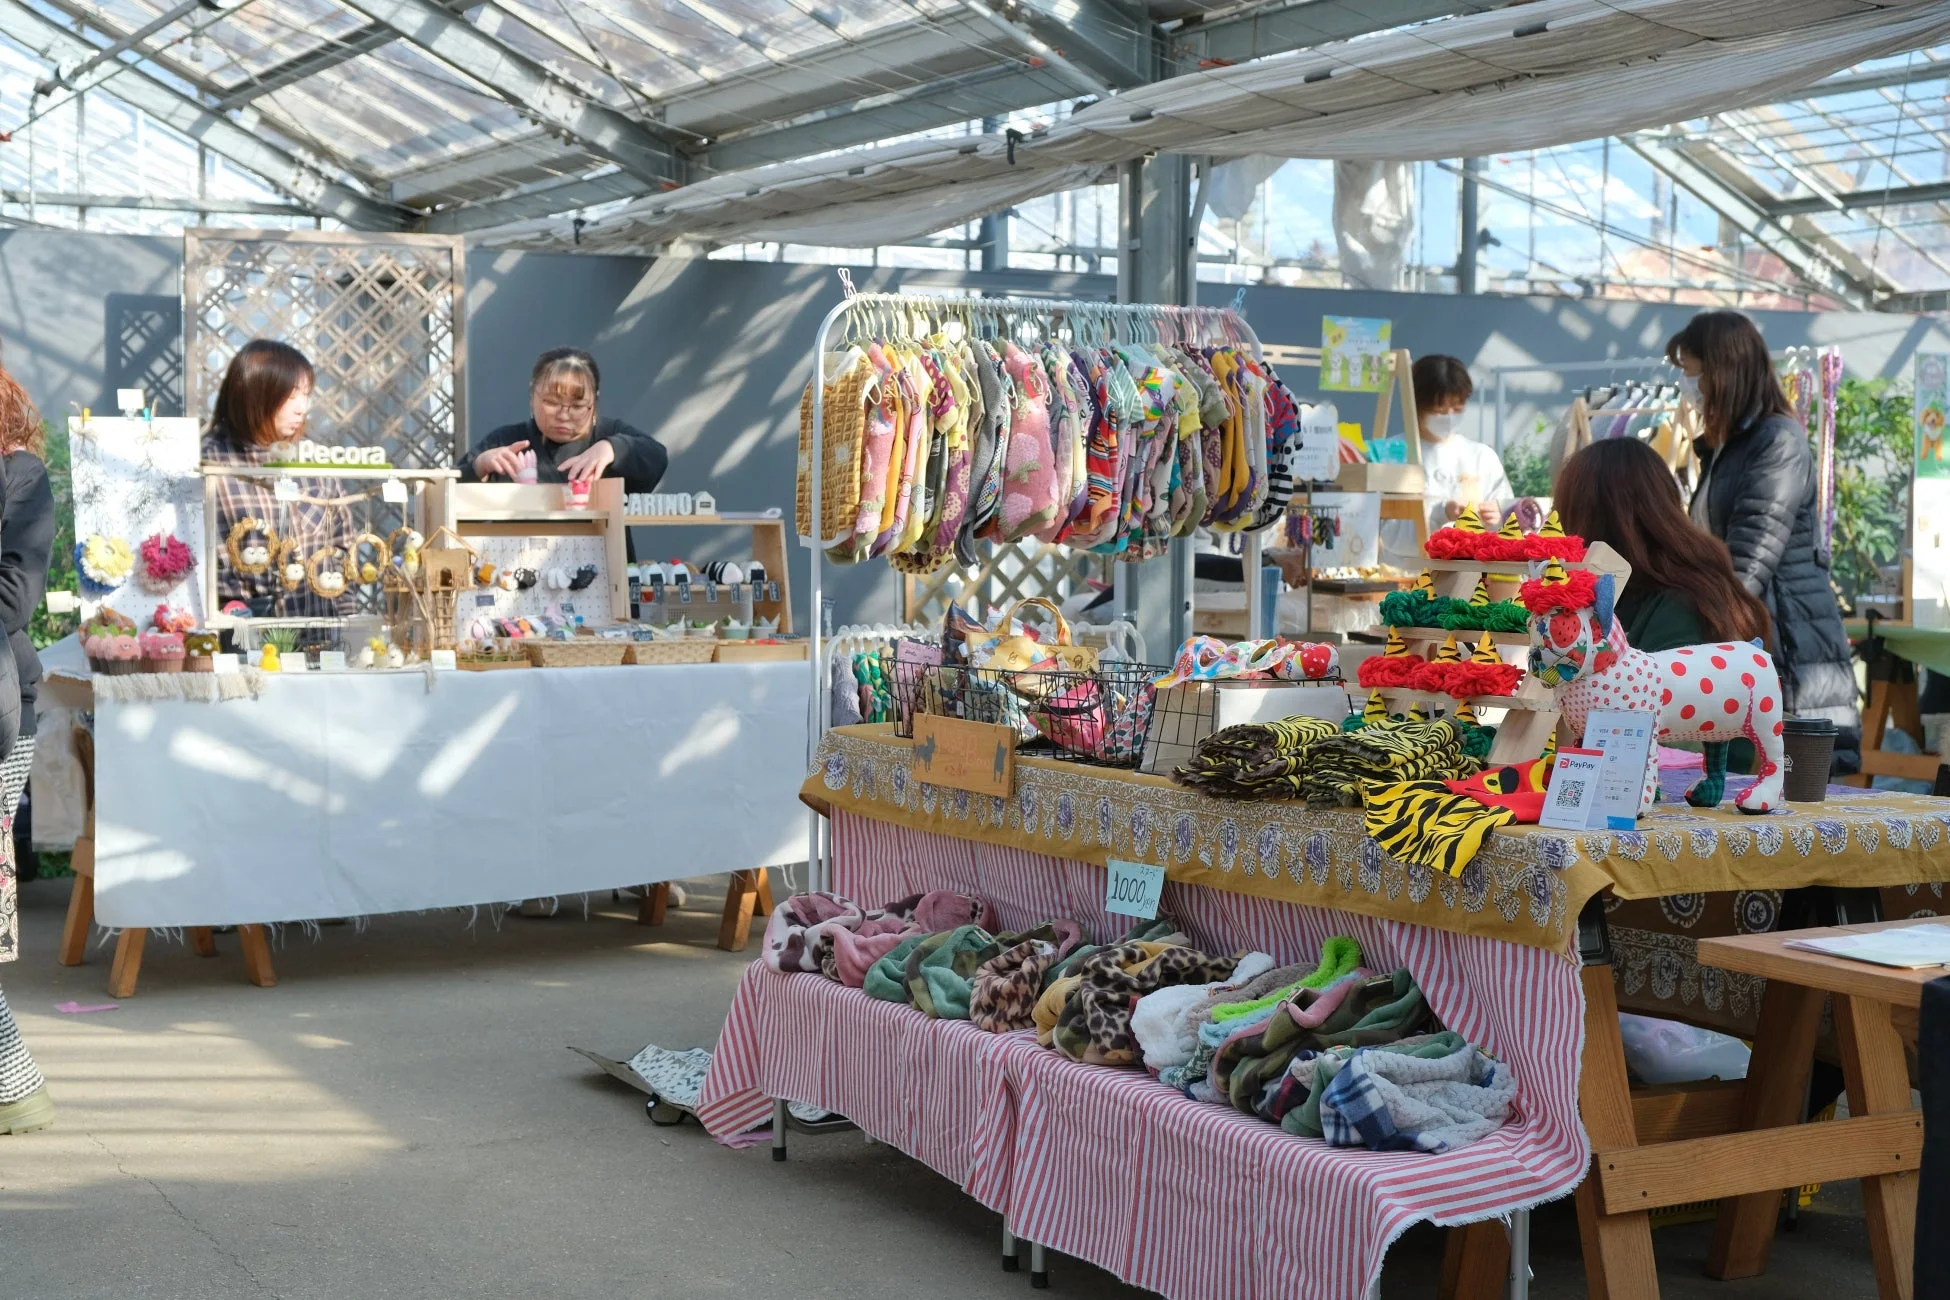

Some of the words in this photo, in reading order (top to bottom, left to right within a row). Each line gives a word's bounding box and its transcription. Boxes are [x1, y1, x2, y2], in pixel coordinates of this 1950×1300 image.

[298, 439, 386, 465] Pecora
[1569, 759, 1596, 771] PayPay
[1111, 870, 1146, 903] 1000
